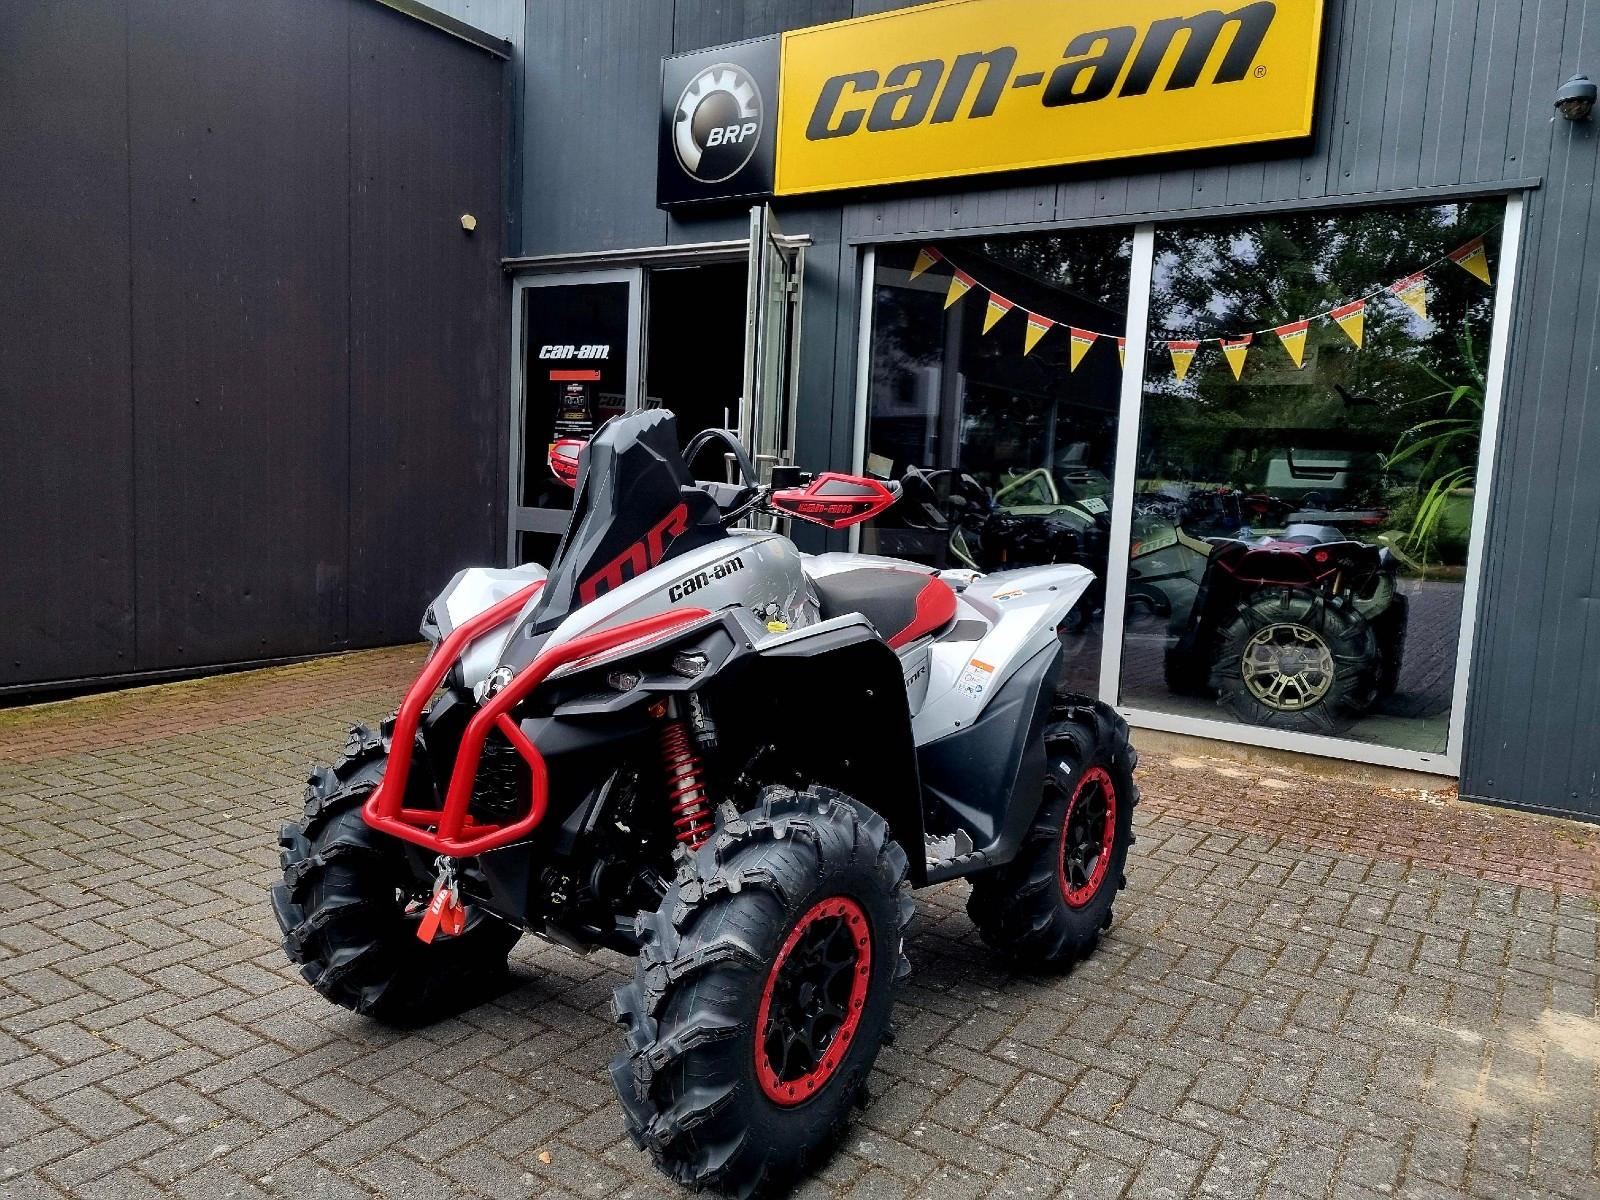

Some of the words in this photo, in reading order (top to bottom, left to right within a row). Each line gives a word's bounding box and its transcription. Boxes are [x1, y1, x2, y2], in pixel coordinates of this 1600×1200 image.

[706, 122, 758, 148] BRP
[539, 344, 610, 360] can-am
[668, 556, 745, 603] can-am
